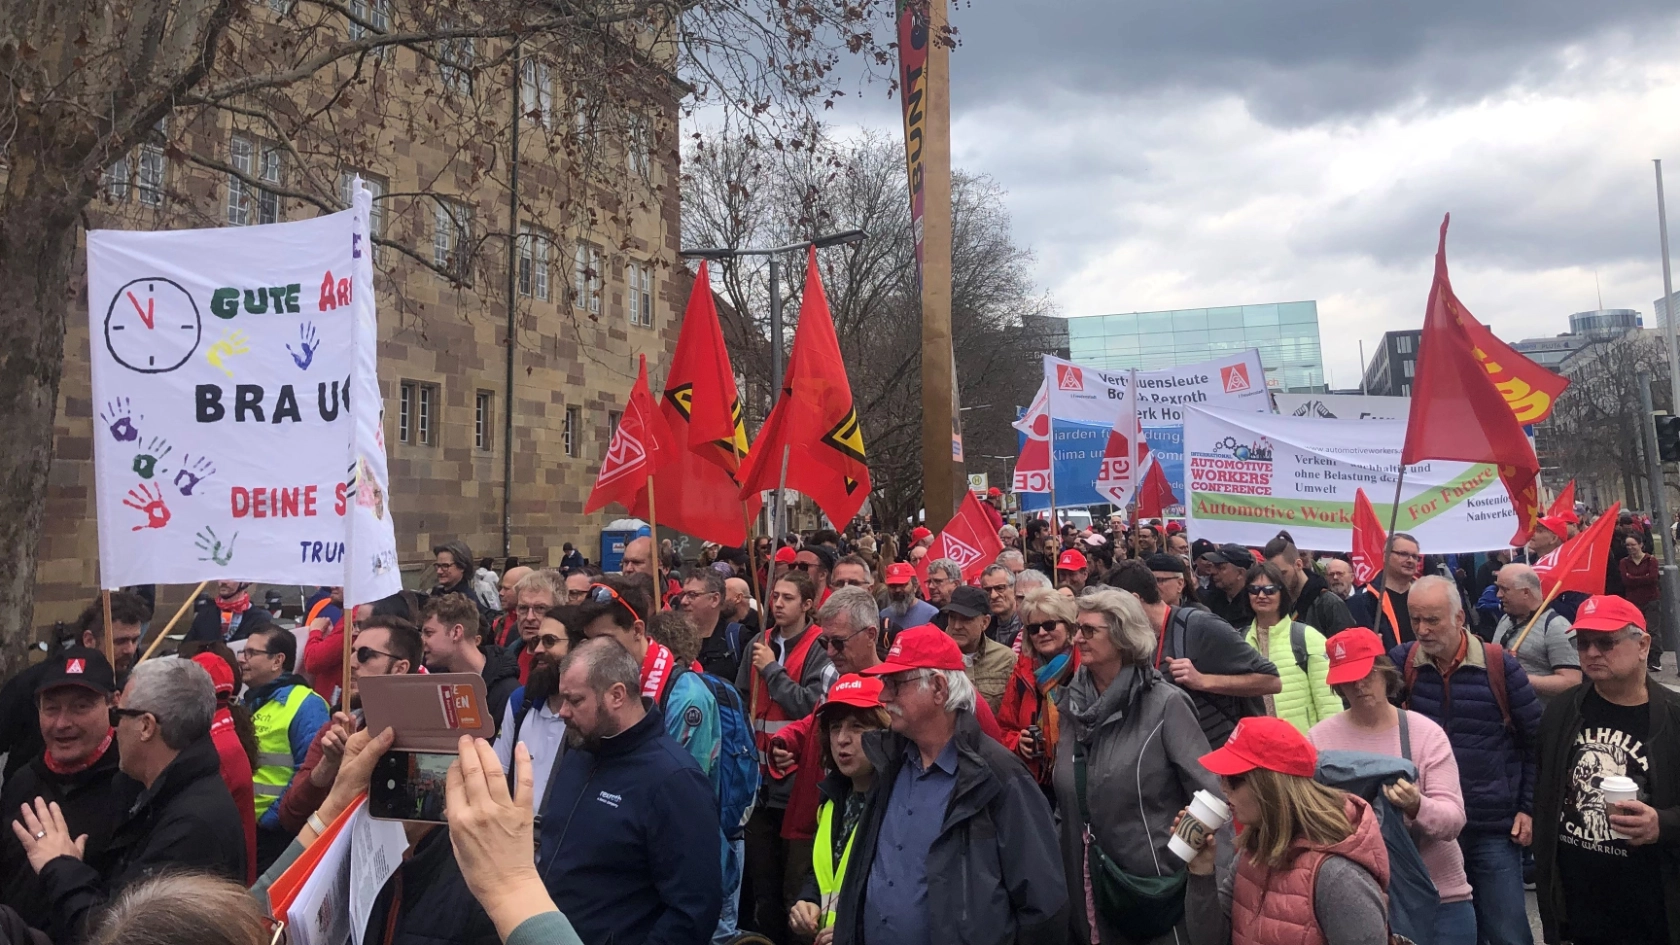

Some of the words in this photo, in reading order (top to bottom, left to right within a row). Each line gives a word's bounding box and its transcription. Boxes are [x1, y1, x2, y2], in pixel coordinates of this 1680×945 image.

[906, 64, 923, 195] BUNT
[210, 283, 301, 320] GUTE
[318, 270, 353, 312] AR
[1190, 457, 1274, 472] AUTOMOTIVE
[1410, 463, 1431, 474] und
[1294, 469, 1320, 480] ohne
[1324, 470, 1378, 484] Belastung
[1190, 481, 1272, 496] CONFERENCE
[1294, 482, 1337, 494] Umwelt
[1407, 498, 1438, 521] For
[1440, 467, 1494, 504] Future
[231, 485, 317, 518] DEINE
[1196, 499, 1295, 521] Automotive
[835, 680, 862, 691] ver.di
[1581, 840, 1629, 858] WARRIOR
